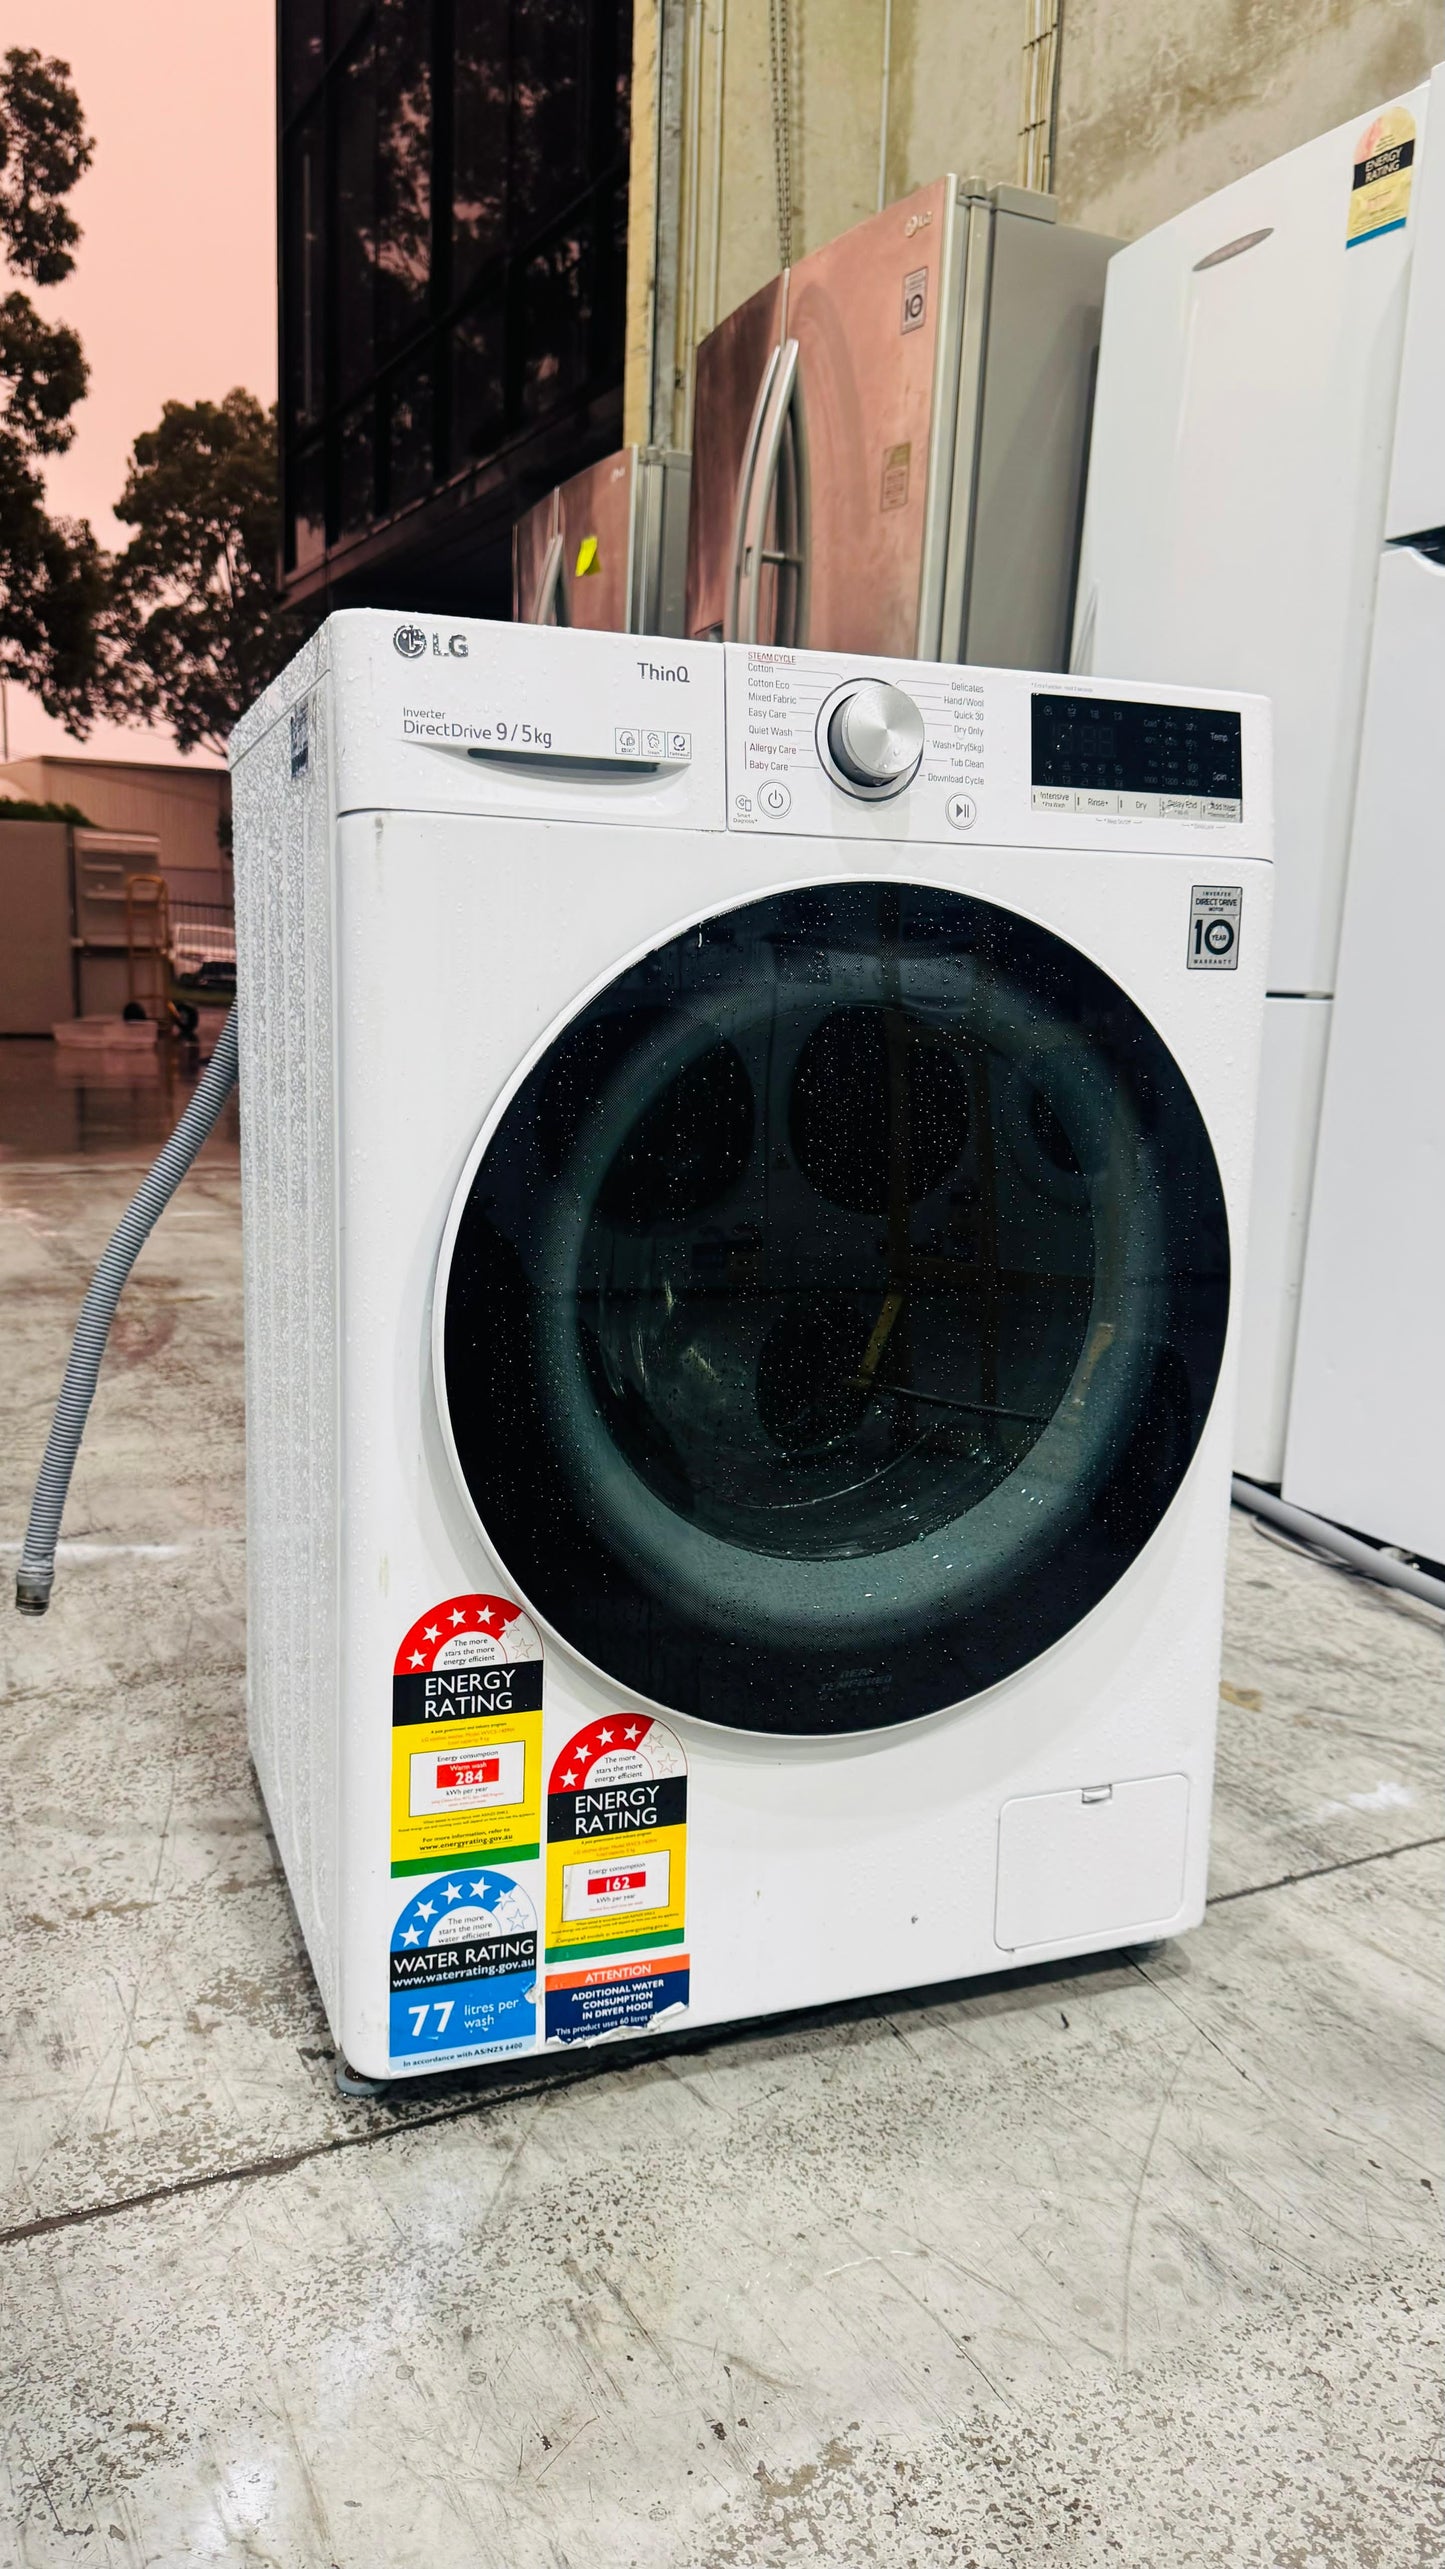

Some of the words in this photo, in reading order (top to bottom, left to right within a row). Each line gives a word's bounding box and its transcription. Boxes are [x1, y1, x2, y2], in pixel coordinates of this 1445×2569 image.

[1365, 147, 1403, 172] ENERGY
[1365, 160, 1400, 183] RATING
[433, 632, 469, 658] LG
[748, 651, 774, 662] STEAM
[774, 655, 796, 664] CYCLE
[637, 662, 690, 683] ThinQ
[748, 663, 774, 673] Cotton
[748, 678, 774, 688] Cotton
[775, 680, 790, 690] Eco
[951, 682, 984, 693] Delicates
[749, 692, 772, 702] Mixed
[773, 694, 797, 704] Fabric
[944, 696, 984, 707] Hand/Wool
[403, 707, 446, 720] Inverter
[749, 707, 767, 719] Easy
[769, 709, 787, 719] Care
[954, 711, 974, 720] Quick
[975, 712, 984, 721] 30
[749, 725, 769, 736] Quiet
[770, 727, 793, 737] Wash
[954, 725, 966, 736] Dry
[968, 726, 984, 737] Only
[749, 743, 777, 755] Allergy
[779, 745, 797, 755] Care
[932, 740, 984, 753] Wash+Dry(5kg)
[749, 760, 769, 771] Baby
[771, 762, 789, 771] Care
[950, 758, 963, 767] Tub
[965, 760, 984, 768] Clean
[928, 773, 963, 784] Download
[965, 776, 984, 786] Cycle
[1040, 792, 1070, 801] Intensive
[1135, 801, 1147, 810] Dry
[1195, 898, 1218, 906] DIRECT
[1194, 918, 1234, 955] 10
[445, 1649, 461, 1657] stars
[476, 1646, 495, 1654] more
[443, 1657, 466, 1666] energy
[468, 1655, 495, 1663] efficient
[424, 1669, 516, 1697] ENERGY
[424, 1692, 513, 1719] RATING
[437, 1755, 458, 1763] Energy
[460, 1750, 499, 1760] consumption
[619, 1754, 636, 1762] more
[450, 1764, 470, 1772] Warm
[596, 1767, 611, 1775] stars
[455, 1769, 484, 1785] 284
[594, 1775, 615, 1783] energy
[617, 1771, 643, 1780] efficient
[475, 1786, 488, 1794] year
[575, 1785, 660, 1814] ENERGY
[575, 1807, 657, 1835] RATING
[419, 1834, 513, 1851] www.energyrating.gov.au
[588, 1867, 607, 1875] Energy
[605, 1877, 630, 1892] 162
[448, 1917, 463, 1925] The
[464, 1914, 484, 1923] more
[439, 1927, 456, 1935] stars
[459, 1925, 470, 1933] the
[472, 1922, 493, 1930] more
[438, 1936, 459, 1944] water
[462, 1931, 490, 1941] efficient
[393, 1951, 459, 1974] WATER
[465, 1940, 534, 1963] RATING
[393, 1957, 535, 1988] www.waterrating.gov.au
[585, 1964, 652, 1983] ATTENTION
[572, 1984, 631, 2001] ADDITIONAL
[632, 1979, 664, 1991] WATER
[583, 1991, 653, 2010] CONSUMPTION
[464, 2003, 494, 2016] litres
[498, 1999, 519, 2013] per
[582, 2011, 592, 2020] IN
[595, 2005, 624, 2018] DRYER
[626, 2001, 653, 2013] MODE
[408, 2000, 455, 2037] 77
[464, 2015, 495, 2029] wash
[556, 2027, 571, 2036] This
[572, 2023, 600, 2034] product
[602, 2020, 618, 2028] uses
[630, 2015, 648, 2023] litres
[413, 2053, 454, 2066] accordance
[456, 2051, 473, 2059] with
